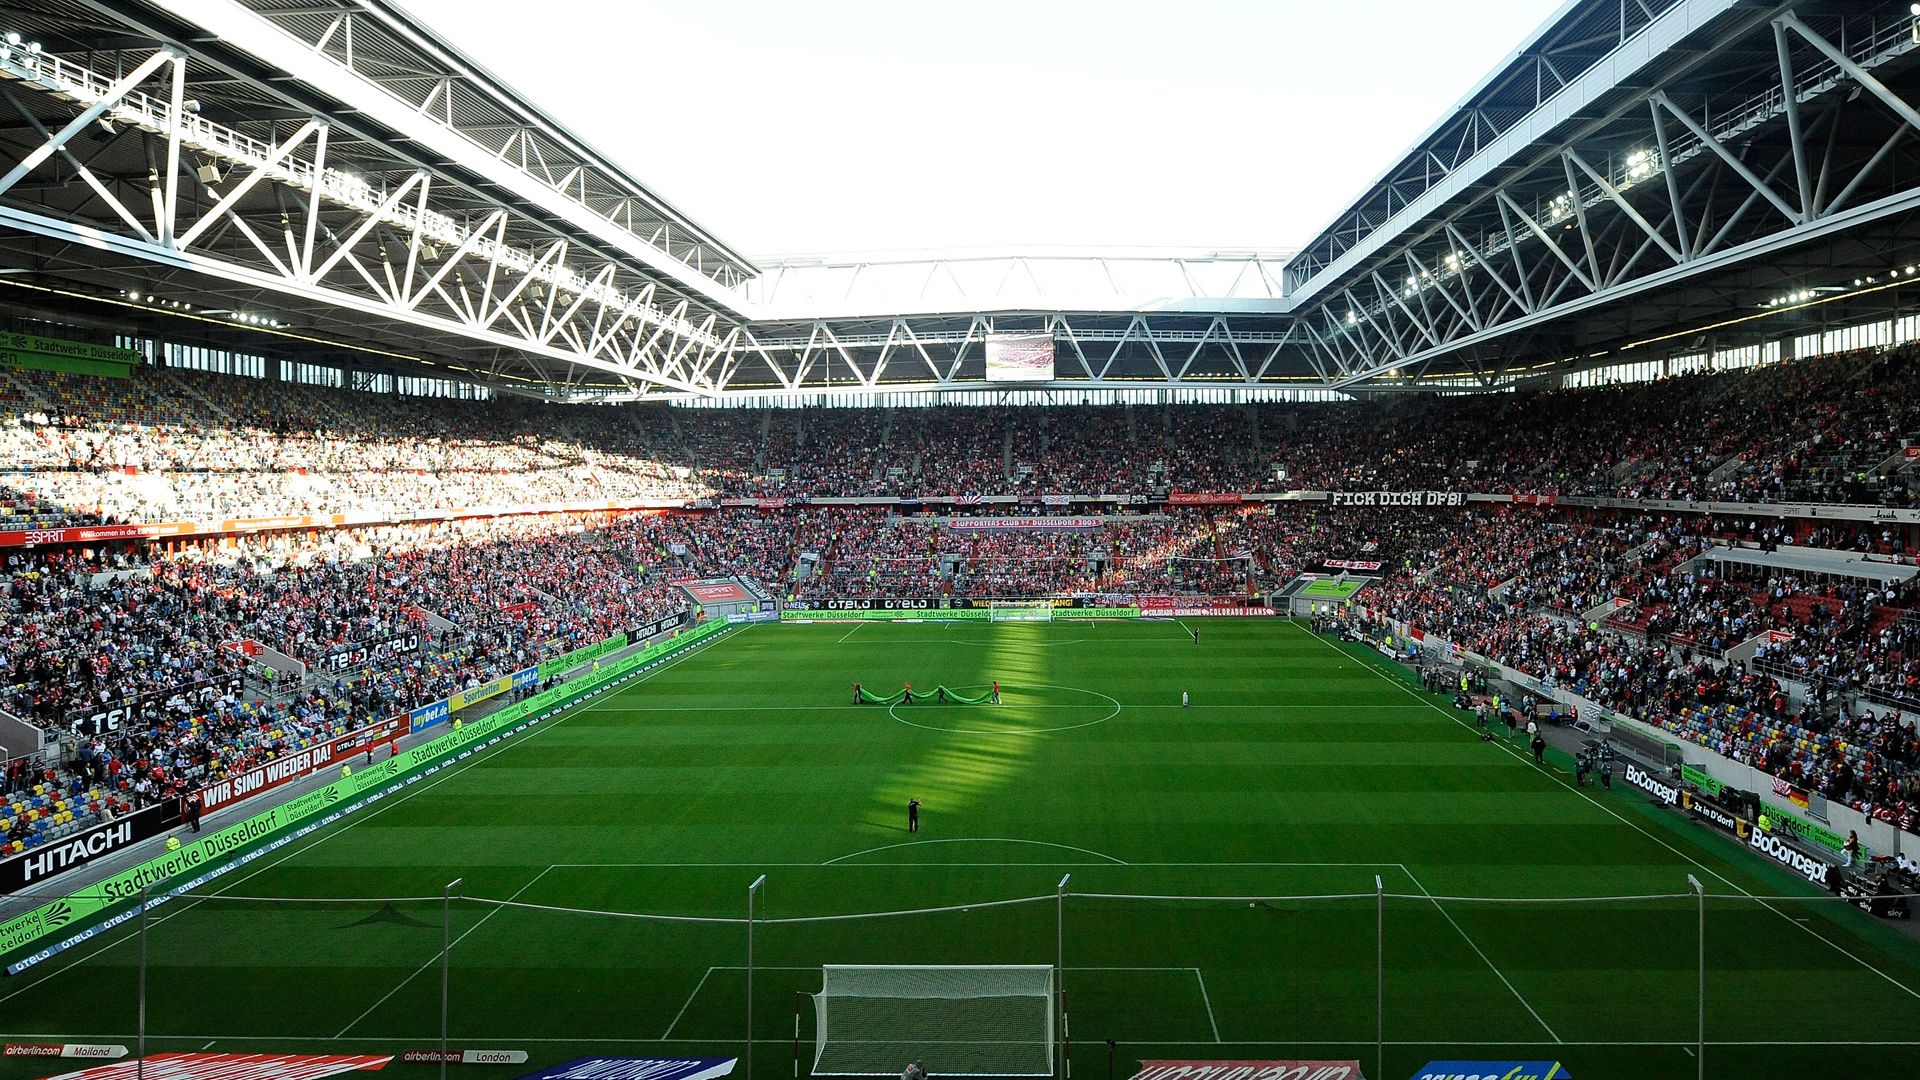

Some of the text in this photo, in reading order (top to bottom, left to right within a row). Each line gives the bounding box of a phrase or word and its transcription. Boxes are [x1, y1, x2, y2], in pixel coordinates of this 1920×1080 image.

[34, 339, 136, 361] Stadtwerke Düsseldorf
[1332, 491, 1462, 506] FICK DICH DFB!
[25, 530, 66, 544] ESPRIT
[80, 530, 118, 539] Willkommen
[126, 528, 137, 536] der
[782, 611, 824, 619] Stadtwerke
[826, 610, 866, 618] Düsseldorf
[916, 610, 958, 618] Stadtwerke
[1051, 609, 1135, 617] Stadtwerke Düsseldorf
[1209, 608, 1267, 616] COLORADO JEANS
[636, 624, 657, 640] HITACHI
[661, 616, 679, 630] HITACHI
[463, 683, 500, 704] Sportwetten
[413, 705, 448, 728] mybet.de
[411, 734, 458, 764] Stadtwerke
[458, 716, 498, 743] Düsseldorf
[203, 744, 331, 808] WIR SIND WIEDER DA!
[1625, 763, 1678, 805] BoConcept
[287, 791, 321, 812] Stadtwerke
[1694, 802, 1734, 829] 2x in D'dorf!
[1765, 805, 1811, 836] Düssldorf
[24, 821, 131, 881] HITACHI
[104, 810, 277, 903] Stadtwerke Düsseldorf
[1751, 826, 1828, 883] BoConcept
[1887, 909, 1903, 918] sky
[6, 1045, 111, 1056] airberlin.com Mailand
[404, 1051, 511, 1062] airberlin.com London
